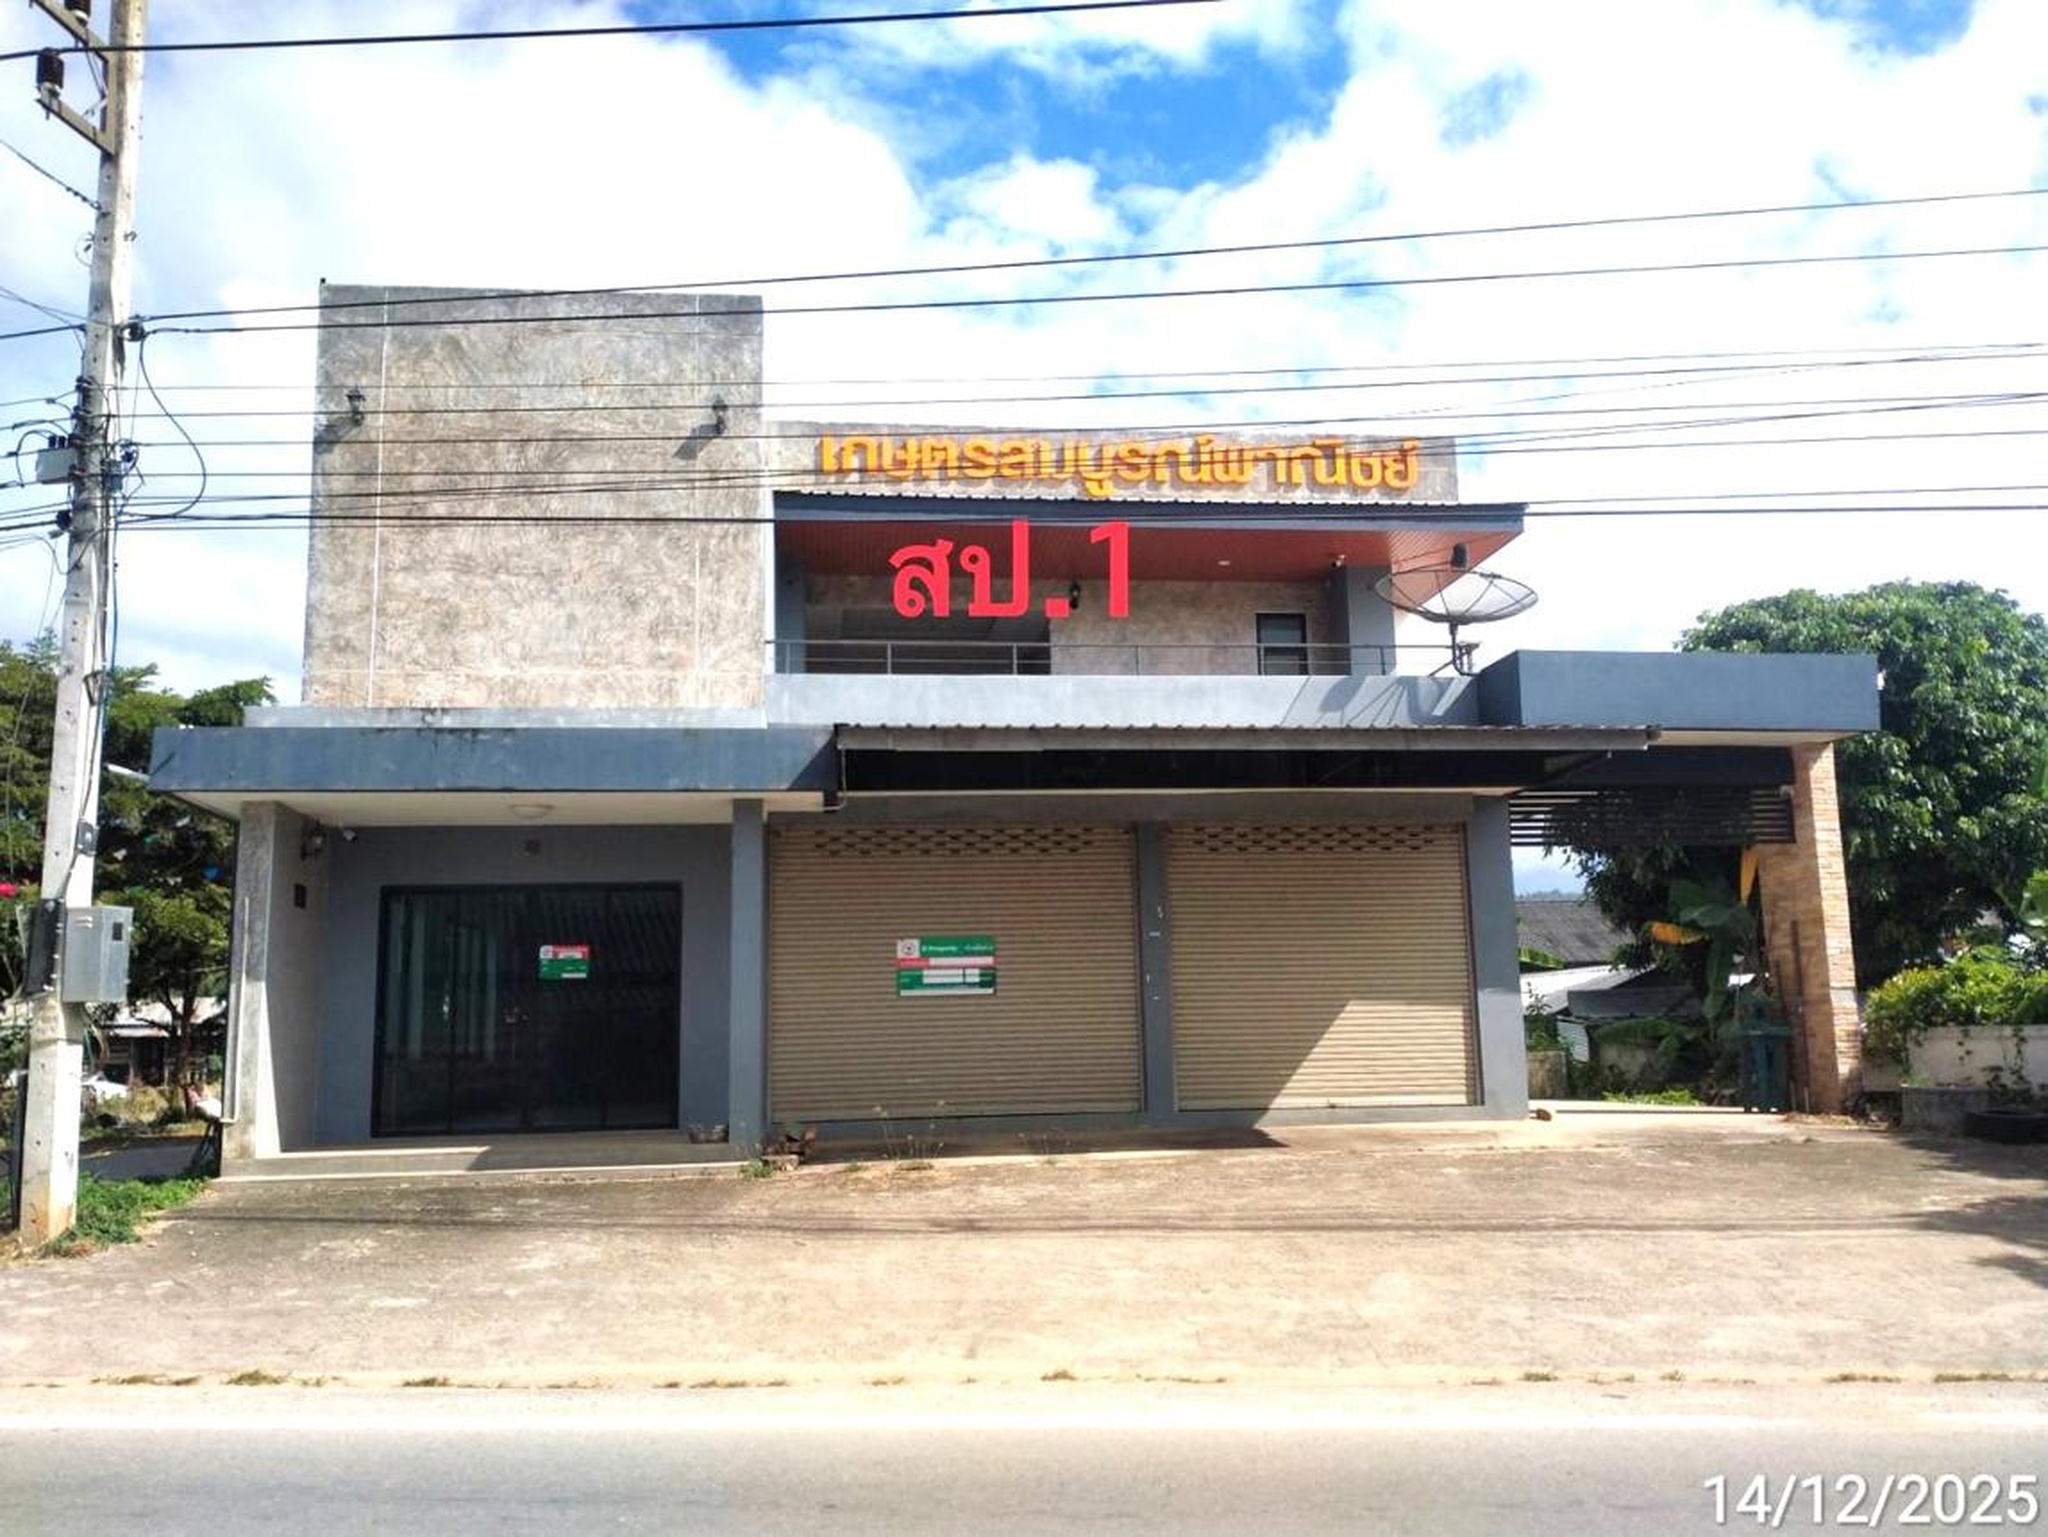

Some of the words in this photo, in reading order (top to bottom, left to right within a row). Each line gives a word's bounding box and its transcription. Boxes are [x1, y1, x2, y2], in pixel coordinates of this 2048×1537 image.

[821, 434, 1419, 497] เกษตรสมบูรณ์พาณิชย์
